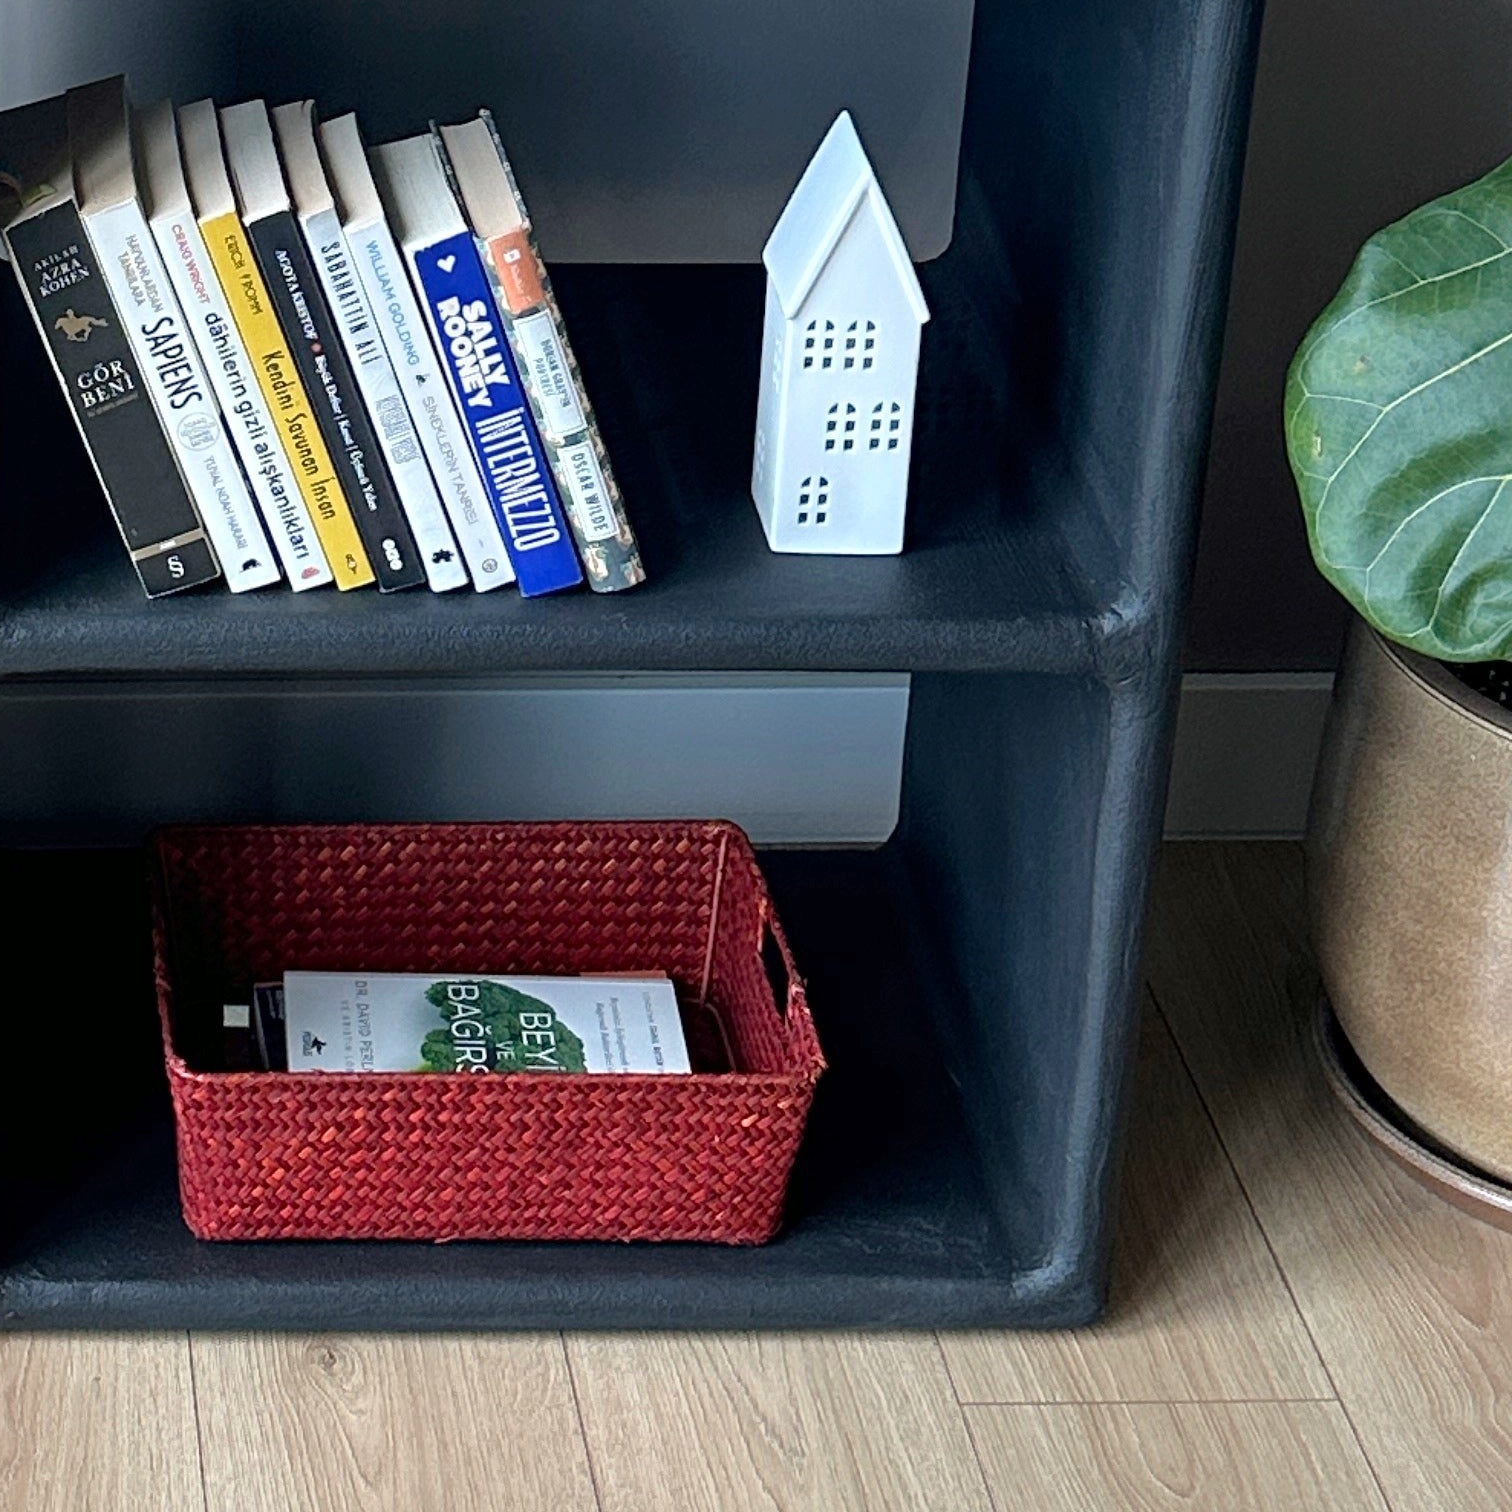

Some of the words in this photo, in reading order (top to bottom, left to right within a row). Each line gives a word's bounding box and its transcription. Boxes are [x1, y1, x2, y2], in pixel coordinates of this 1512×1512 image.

[39, 266, 90, 299] KOHEN
[41, 258, 83, 286] AZRA
[224, 234, 246, 270] ERICH
[274, 248, 300, 293] AGOTA
[365, 239, 397, 307] WILLIAM
[387, 302, 420, 367] GOLDING
[461, 298, 511, 386] SALLY
[77, 359, 125, 389] GÖR
[141, 316, 203, 410] SAPIENS
[436, 295, 494, 408] ROONEY
[261, 349, 296, 411] Kendini
[284, 411, 320, 476] Savunan
[310, 476, 337, 521] İnsan
[233, 401, 268, 440] gizli
[253, 441, 311, 561] alışkanlıkları
[475, 406, 561, 553] İNTERMEZZO
[569, 451, 596, 491] OSCAR
[584, 492, 609, 533] WILDE
[360, 1040, 374, 1072] PERL
[447, 984, 492, 1073] BAĞIRS
[495, 1040, 516, 1061] VE
[519, 1012, 567, 1072] BEYİ
